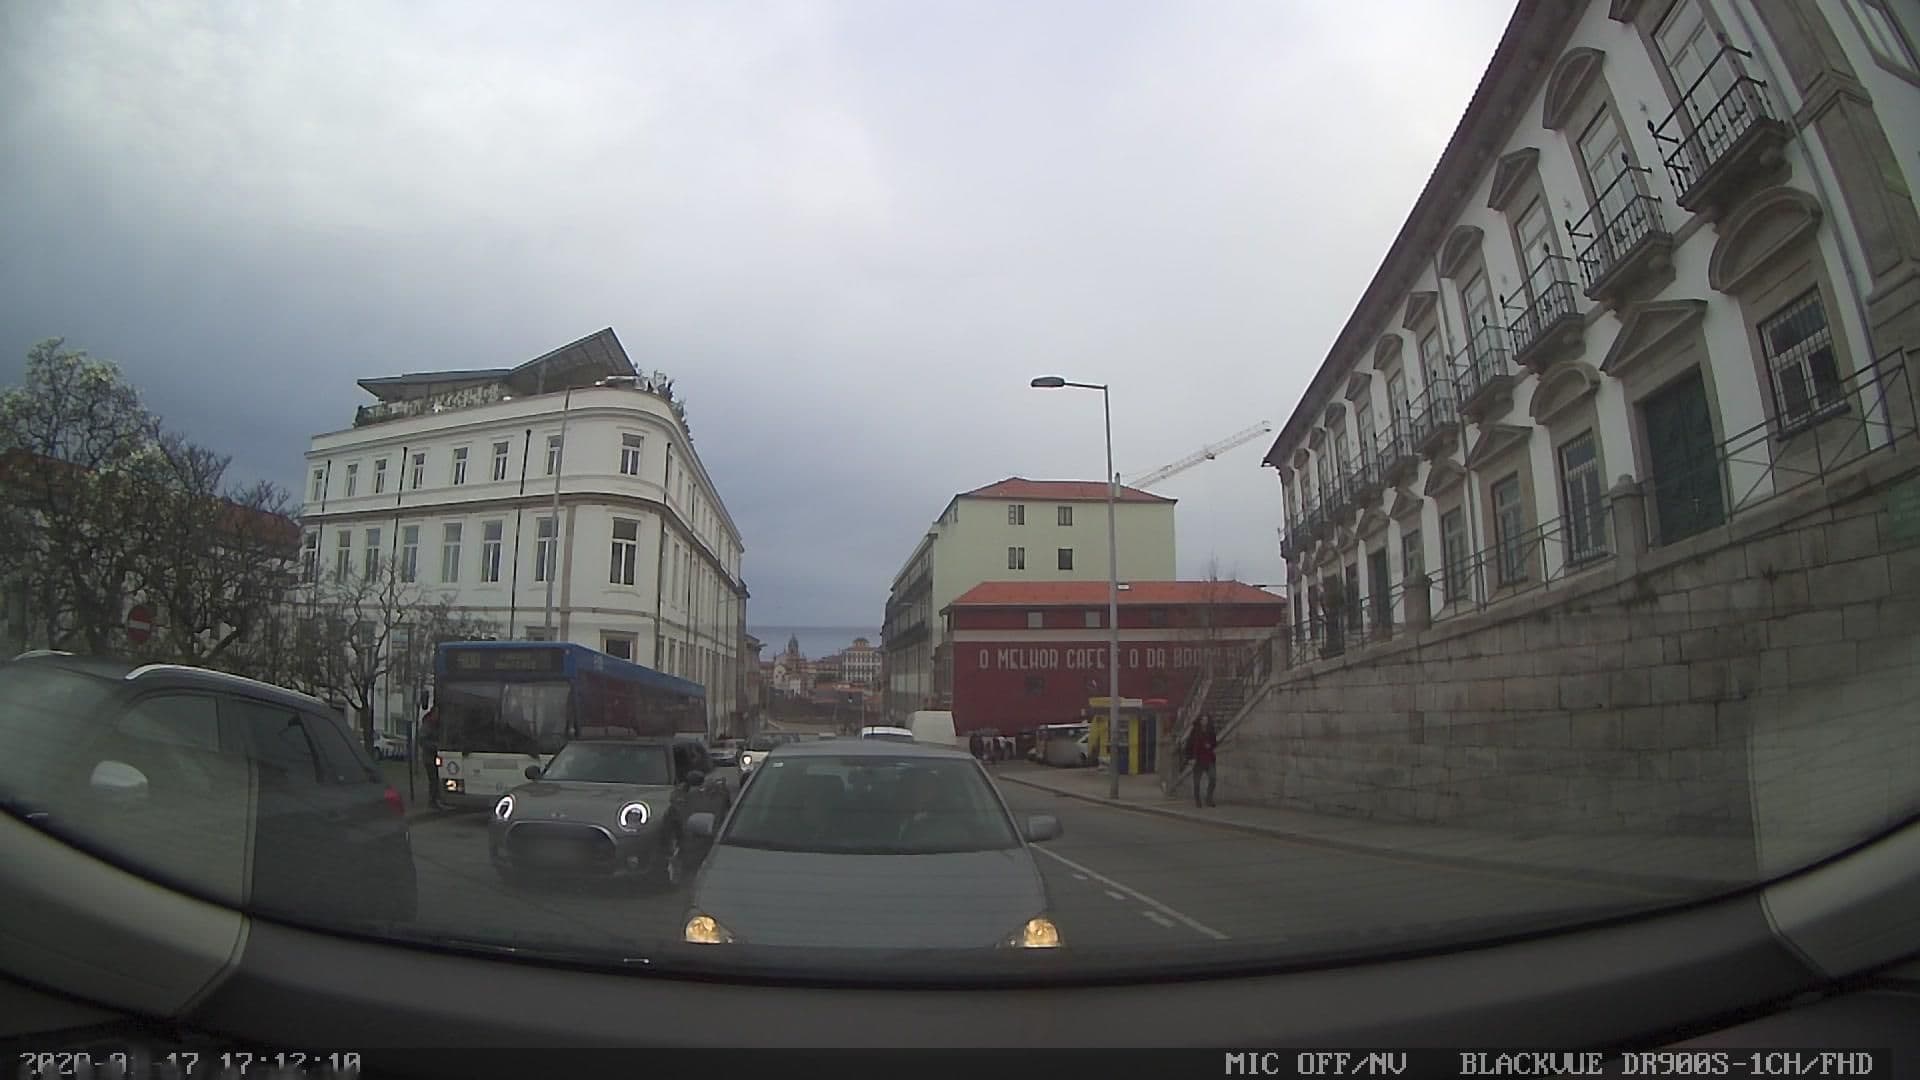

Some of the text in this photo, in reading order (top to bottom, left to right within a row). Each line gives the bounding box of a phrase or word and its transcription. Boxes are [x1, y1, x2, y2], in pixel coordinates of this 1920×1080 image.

[979, 649, 989, 669] O
[997, 648, 1059, 670] MELHOR
[1129, 648, 1139, 669] O
[1146, 648, 1166, 669] DA
